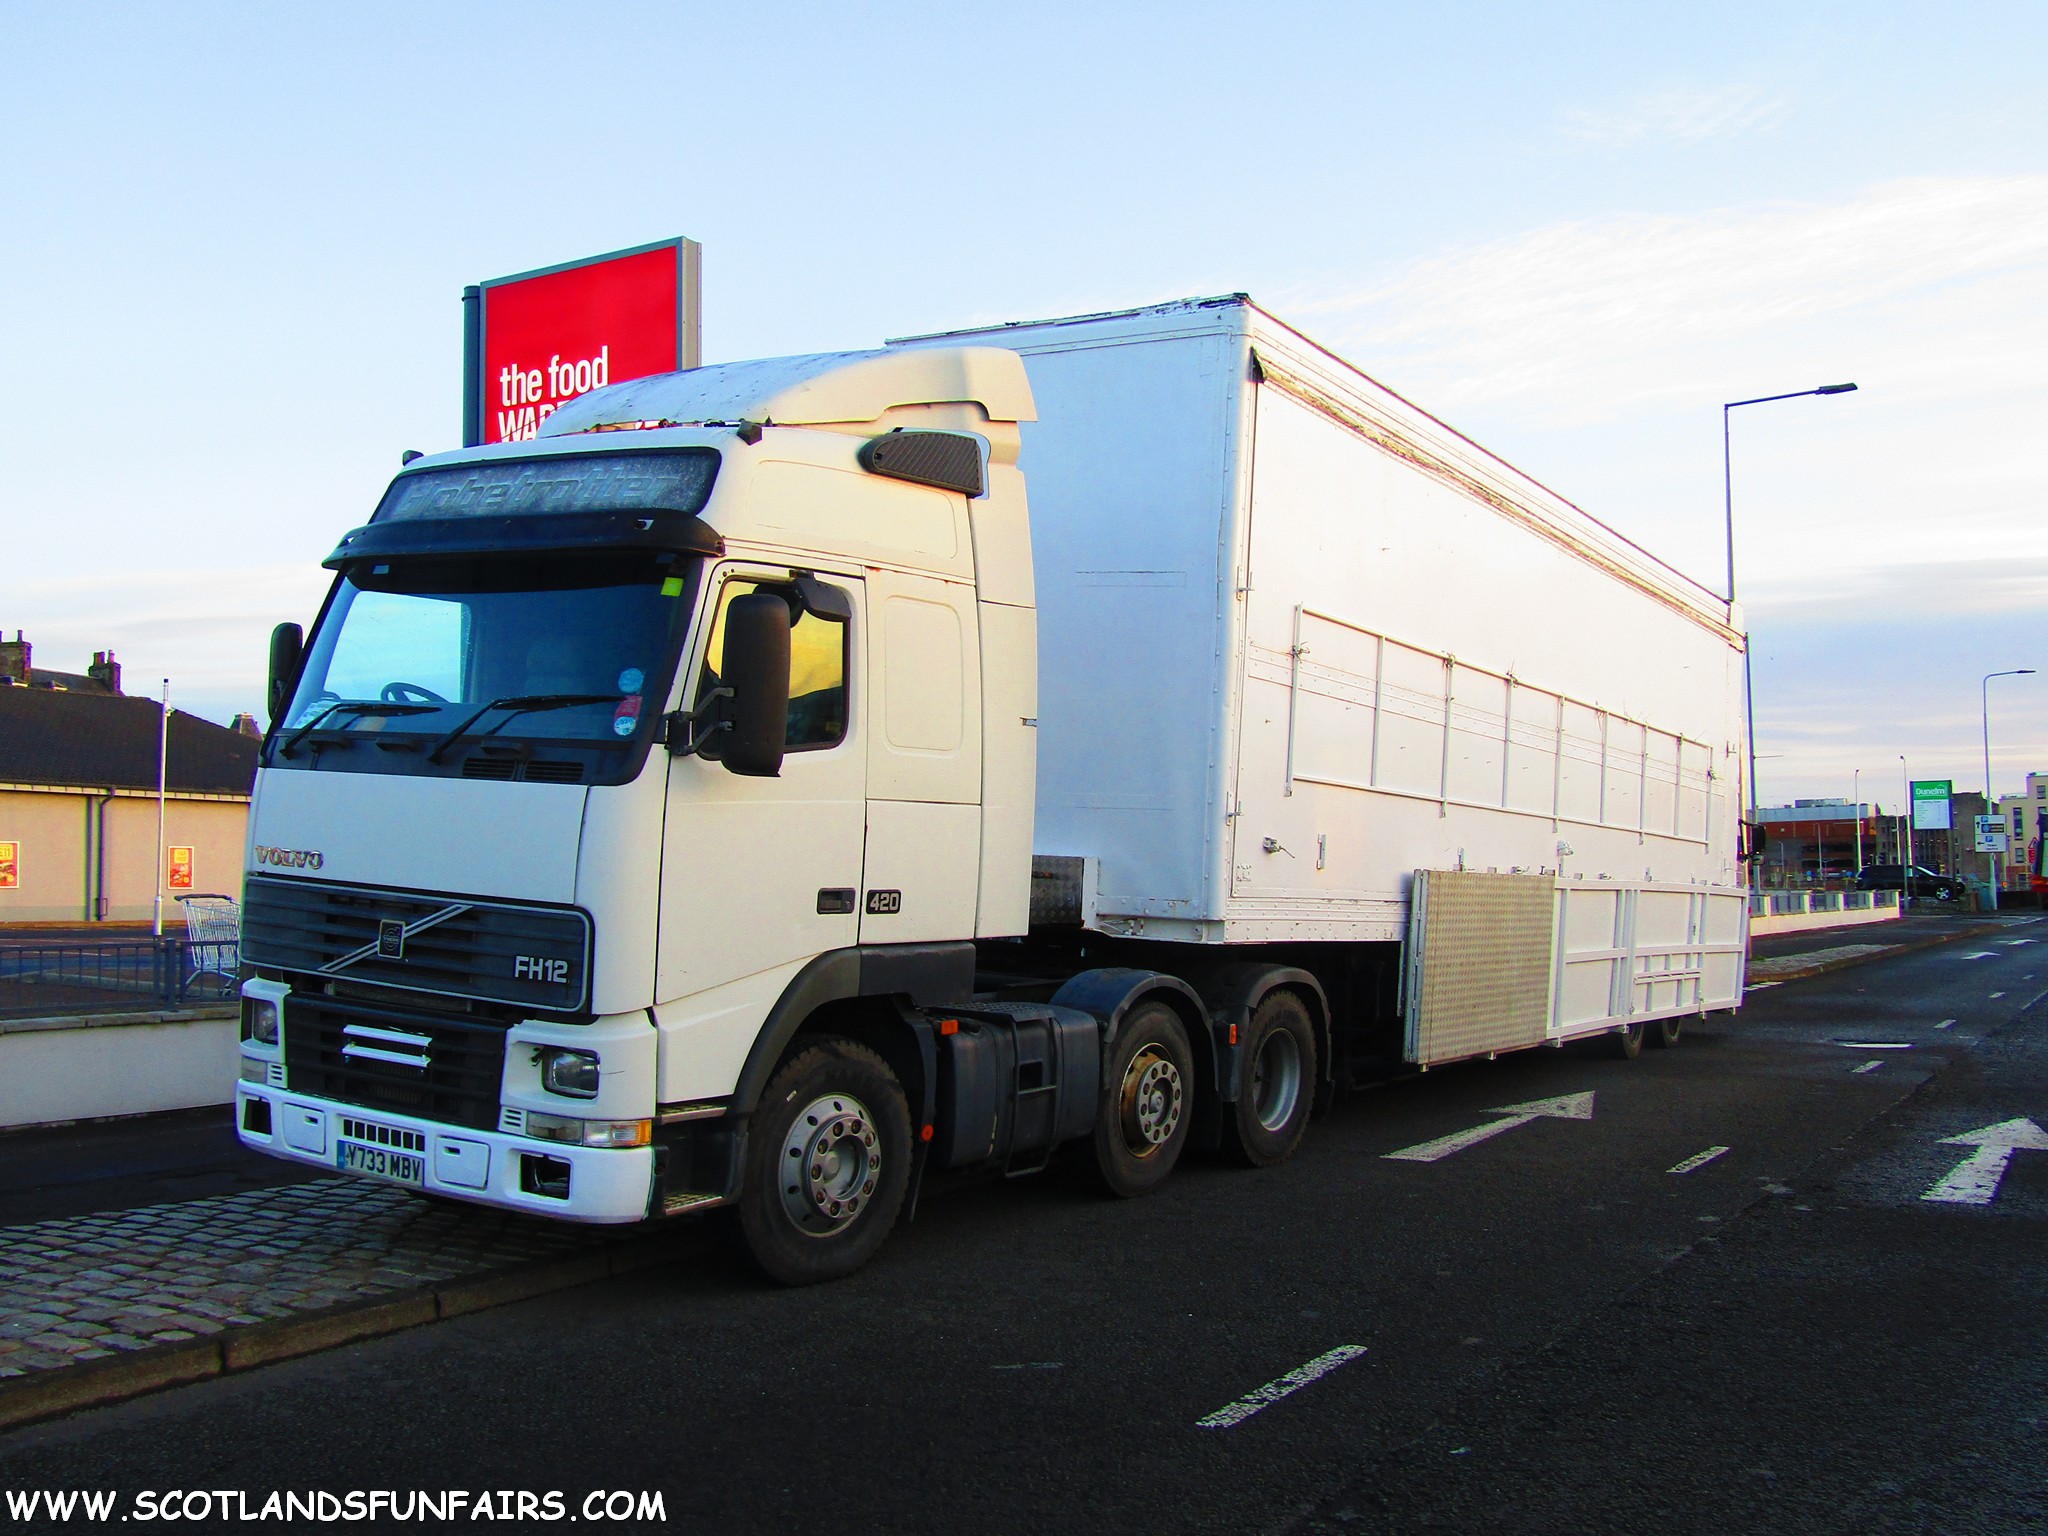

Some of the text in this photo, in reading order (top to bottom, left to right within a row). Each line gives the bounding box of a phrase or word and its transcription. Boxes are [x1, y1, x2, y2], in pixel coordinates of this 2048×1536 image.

[500, 345, 608, 407] the food
[401, 468, 678, 513] Globetrotter
[255, 845, 324, 870] VOLVO
[870, 893, 899, 910] 420
[515, 955, 568, 983] FH12
[347, 1145, 421, 1181] Y733 MBV
